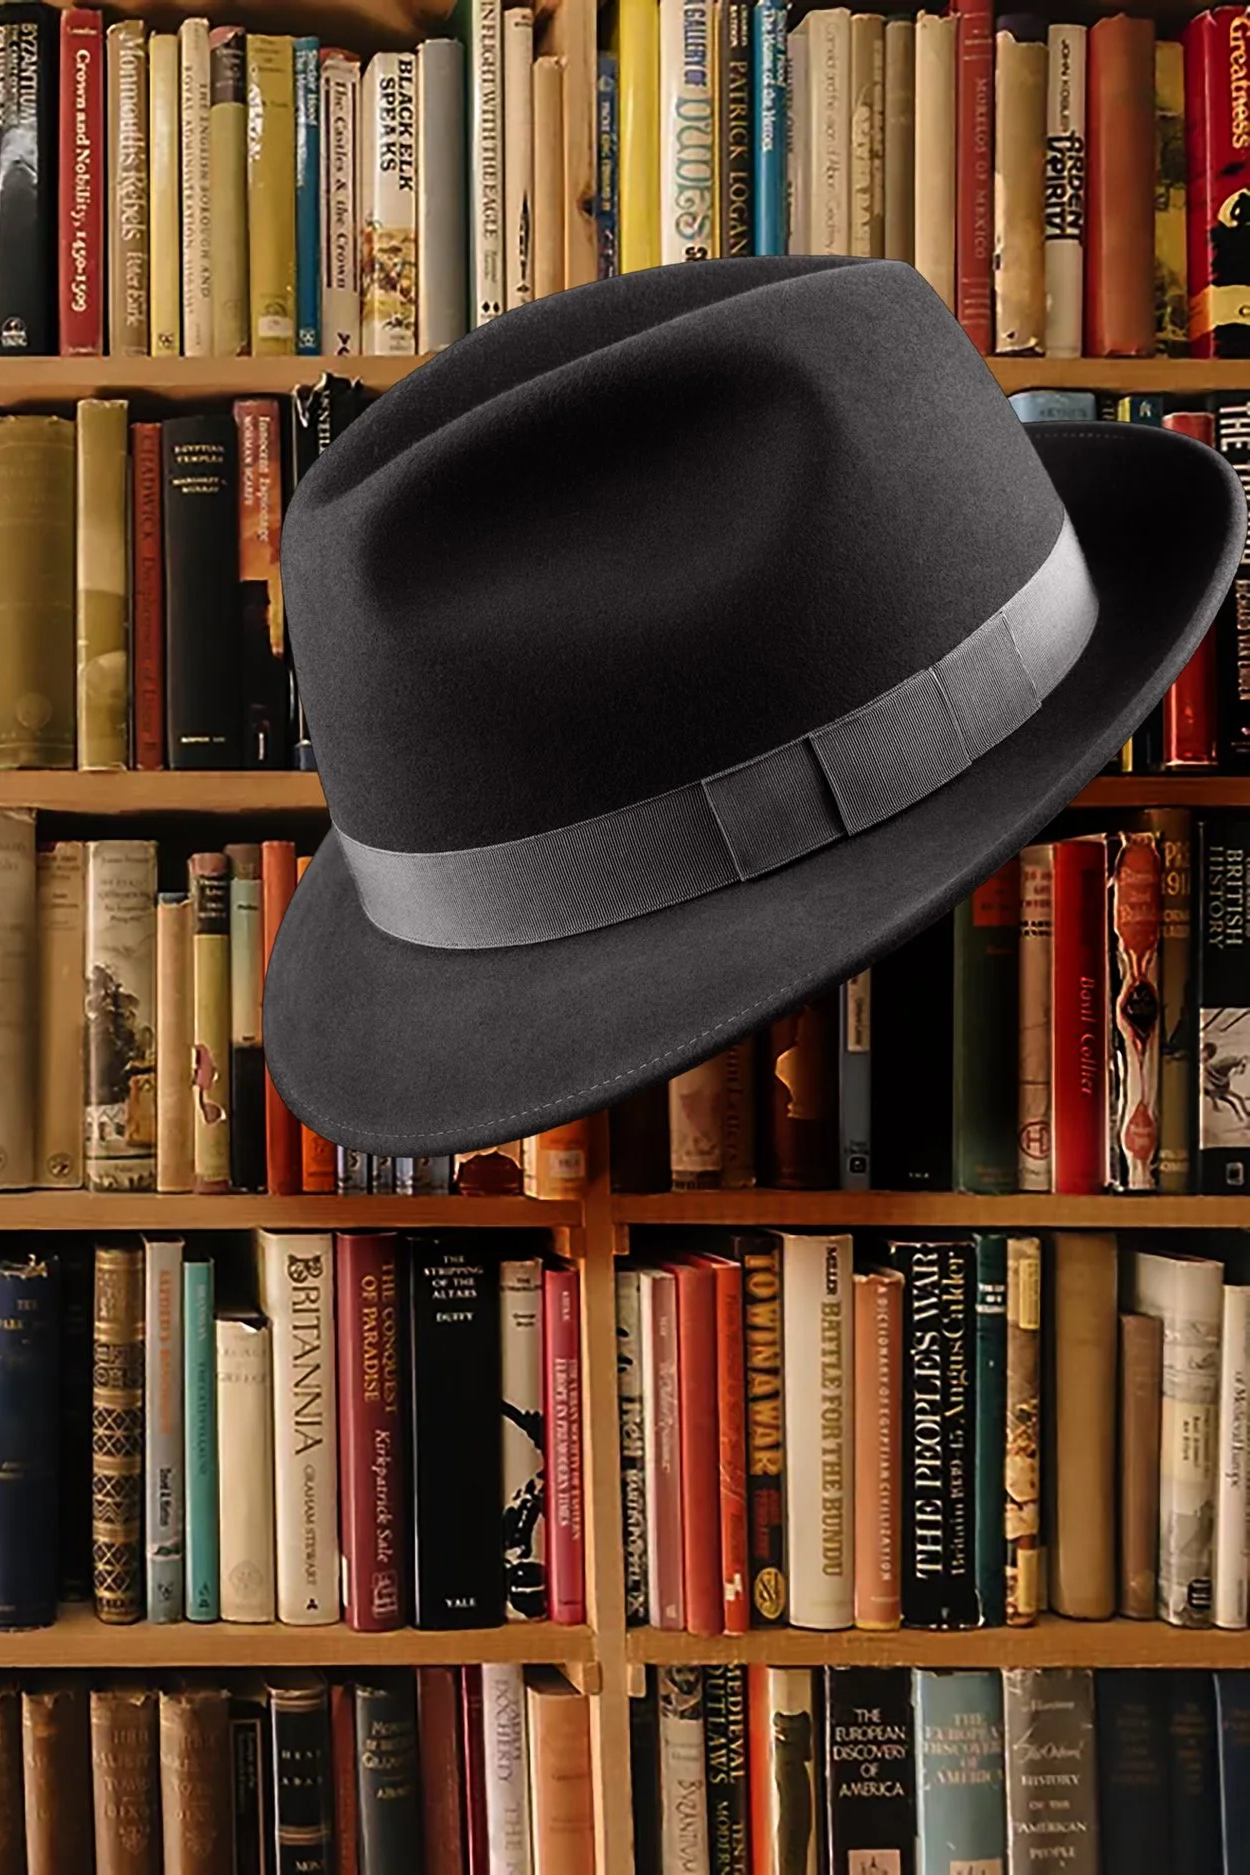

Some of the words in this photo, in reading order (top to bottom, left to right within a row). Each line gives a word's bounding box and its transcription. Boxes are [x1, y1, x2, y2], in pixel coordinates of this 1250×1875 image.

[482, 1, 496, 28] IN
[684, 8, 707, 70] GALLERY
[19, 24, 38, 124] BYZANTIUM
[75, 49, 91, 110] Crown
[482, 29, 497, 85] FLIGHT
[684, 69, 707, 88] OF
[1230, 17, 1250, 148] Greatness
[119, 34, 146, 167] Monmouth's
[334, 81, 348, 112] The
[398, 59, 414, 139] BLACK
[482, 90, 497, 144] WITH
[729, 60, 750, 161] PATRICK
[75, 111, 90, 146] and
[334, 116, 348, 173] Castles
[379, 77, 397, 172] SPEAKS
[71, 147, 91, 228] Nobility,
[334, 178, 347, 192] &
[398, 142, 414, 192] ELK
[483, 145, 499, 186] THE
[974, 162, 987, 180] OF
[1068, 135, 1085, 249] ARDENT
[119, 171, 147, 241] Rebels
[334, 200, 348, 229] the
[483, 187, 500, 239] EAGLE
[728, 172, 750, 256] LOGAN
[974, 189, 987, 259] MEXICO
[71, 230, 90, 313] 1450-1509
[334, 233, 347, 289] Crown
[1220, 402, 1250, 452] THE
[1209, 845, 1225, 950] HISTORY
[1226, 849, 1243, 945] BRITISH
[1080, 976, 1097, 1023] Basil
[1080, 1033, 1096, 1096] Collier
[380, 1262, 396, 1301] THE
[423, 1265, 484, 1276] STRIPPING
[432, 1278, 448, 1288] OF
[453, 1277, 475, 1287] THE
[442, 1255, 464, 1265] THE
[744, 1250, 781, 1298] TO
[825, 1245, 840, 1297] MILLER
[912, 1252, 940, 1320] WAR
[361, 1274, 378, 1303] OF
[432, 1288, 478, 1300] ALTARS
[876, 1283, 887, 1294] A
[436, 1311, 474, 1323] DUFFY
[747, 1300, 782, 1369] WIN
[877, 1298, 890, 1383] DICTIONARY
[287, 1254, 325, 1456] BRITANNIA
[362, 1307, 380, 1403] PARADISE
[380, 1306, 398, 1414] CONQUEST
[821, 1300, 844, 1389] BATTLE
[747, 1370, 781, 1396] A
[878, 1386, 890, 1405] OF
[748, 1397, 783, 1476] WAR
[821, 1394, 844, 1440] FOR
[912, 1332, 943, 1488] PEOPLE'S
[821, 1445, 844, 1491] THE
[878, 1408, 891, 1479] EGYPTIAN
[303, 1463, 317, 1525] GRAHAM
[370, 1429, 392, 1525] Kirkpatrick
[305, 1526, 318, 1587] STEWART
[376, 1529, 391, 1563] Sale
[822, 1496, 845, 1577] BUNDU
[879, 1481, 892, 1582] CIVILIZATION
[913, 1499, 943, 1580] THE
[444, 1598, 477, 1608] YALE
[725, 1664, 746, 1784] MEDIEVAL
[834, 1725, 906, 1741] EUROPEAN
[853, 1707, 882, 1723] THE
[953, 1712, 984, 1726] THE
[832, 1744, 910, 1760] DISCOVERY
[860, 1763, 880, 1778] OF
[838, 1781, 905, 1798] AMERICA
[1021, 1774, 1080, 1786] HISTORY
[504, 1802, 522, 1850] THE
[1017, 1821, 1087, 1833] AMERICAN
[1028, 1847, 1075, 1859] PEOPLE
